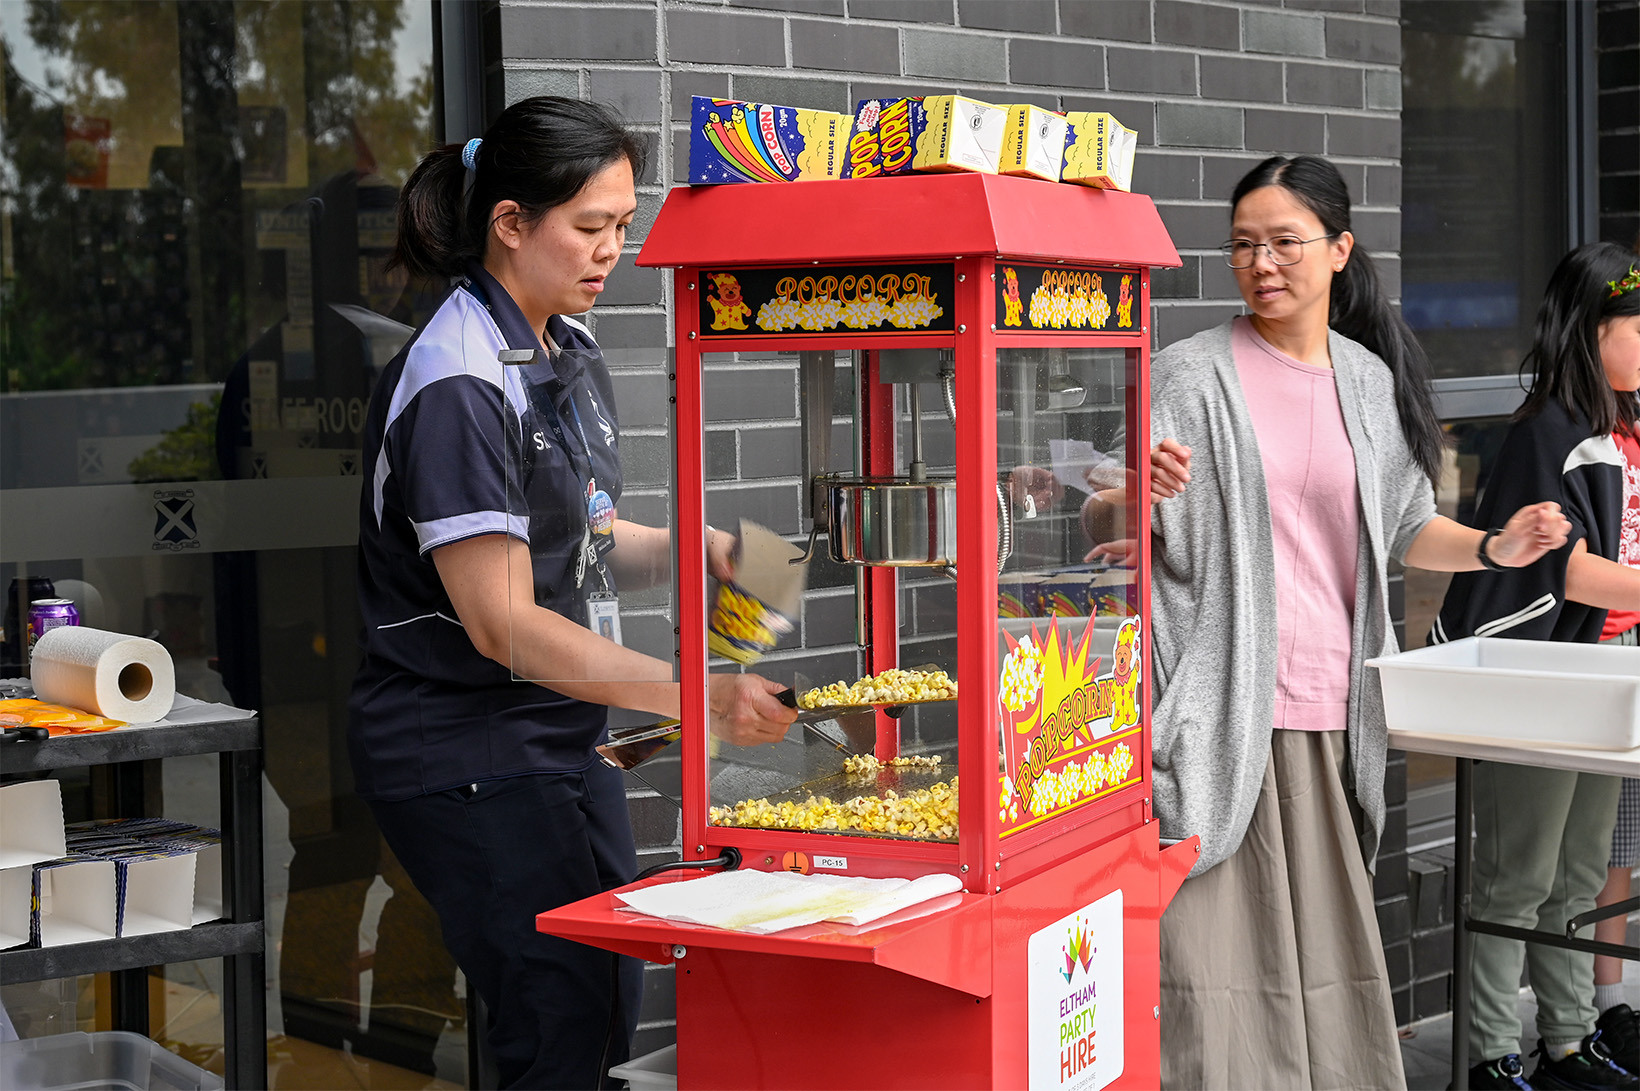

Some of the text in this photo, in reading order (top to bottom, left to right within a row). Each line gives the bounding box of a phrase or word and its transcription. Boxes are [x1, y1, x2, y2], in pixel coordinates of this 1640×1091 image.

[761, 111, 789, 172] POP CORN
[779, 108, 789, 128] 20gm
[878, 98, 913, 172] CORN
[939, 100, 951, 159] REGULAR SIZE
[1015, 109, 1026, 165] REGULAR SIZE
[827, 119, 836, 176] REGULAR SIZE
[849, 131, 882, 179] POP
[1096, 136, 1104, 171] REGULAR
[775, 272, 938, 305] POPCORN
[1041, 269, 1104, 299] POPCORN
[1015, 677, 1115, 814] POPCORN
[821, 858, 843, 867] PC-15
[1059, 980, 1097, 1018] ELTHAM
[1060, 1004, 1097, 1047] PARTY
[1060, 1030, 1097, 1084] HIRE
